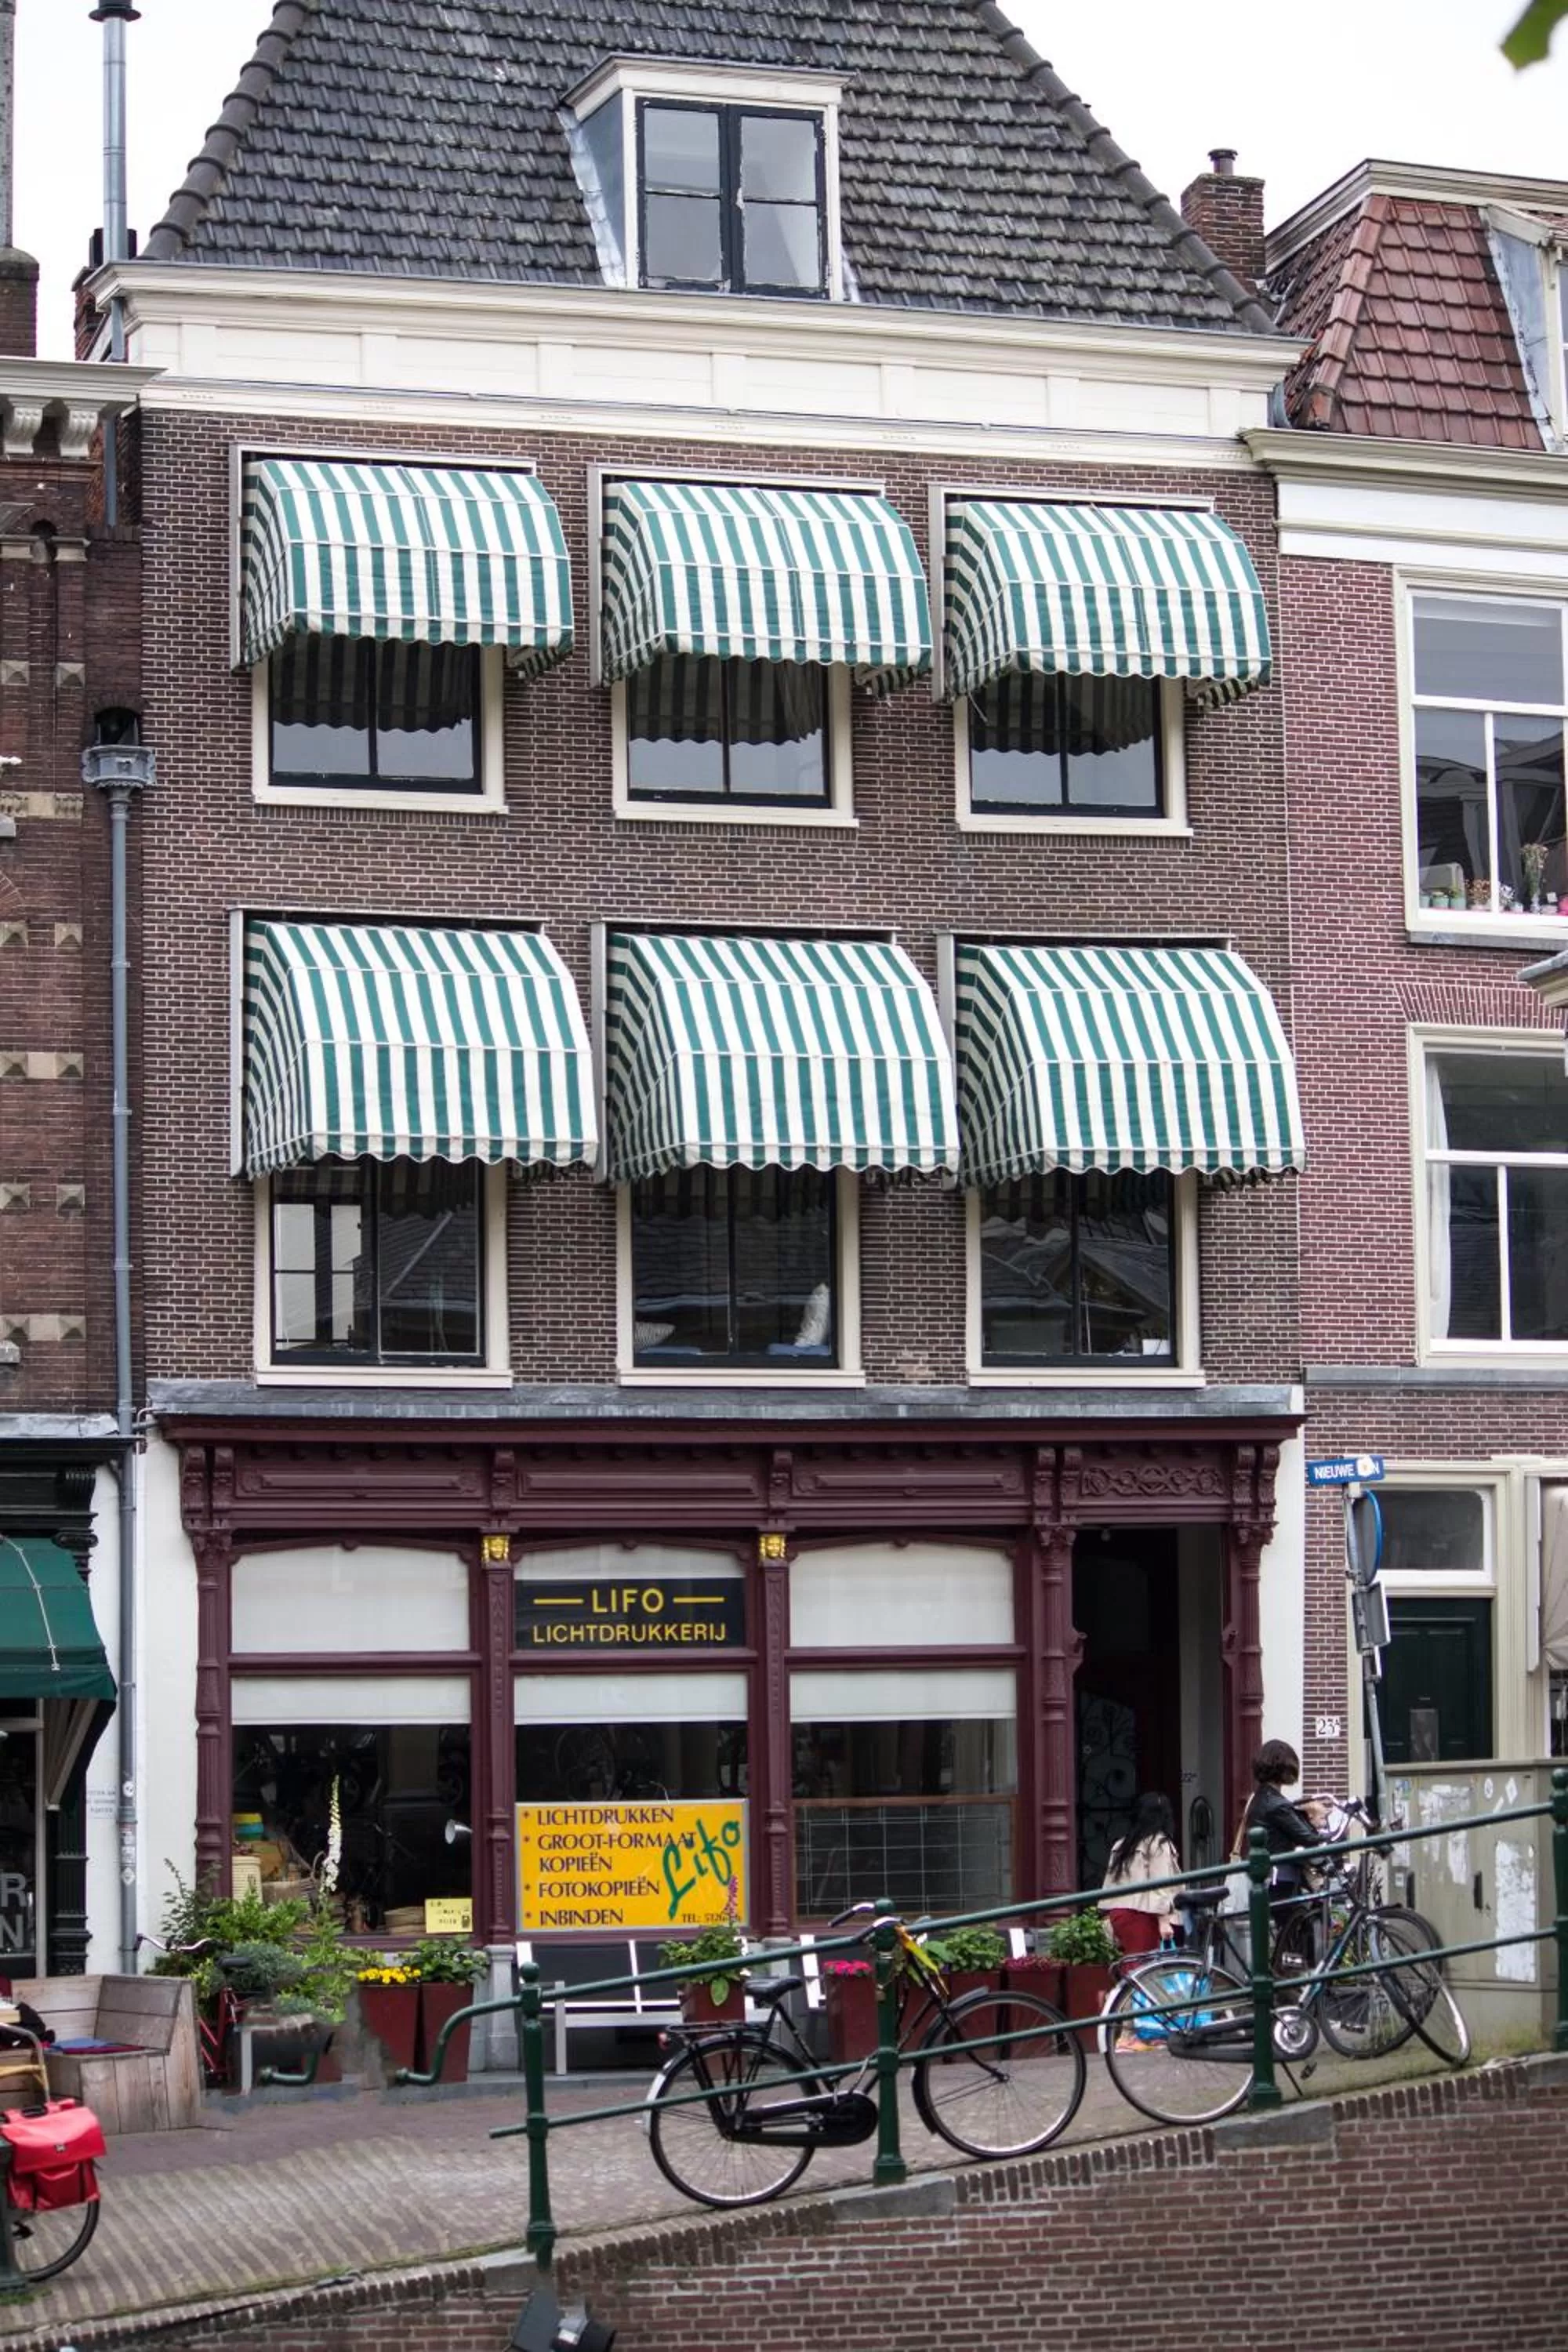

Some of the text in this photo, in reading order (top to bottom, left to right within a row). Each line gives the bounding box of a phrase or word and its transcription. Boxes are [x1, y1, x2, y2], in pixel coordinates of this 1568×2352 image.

[1314, 1464, 1355, 1479] NIEUWE
[592, 1588, 664, 1613] LIFO
[533, 1623, 726, 1643] LICHTDRUKKERIJ
[537, 1808, 674, 1826] LICHTDRUKKEN
[537, 1831, 697, 1850] GROOT-FORMAAT
[539, 1853, 612, 1873] KOPIEËN
[662, 1819, 741, 1919] Lifo
[539, 1876, 660, 1898] FOTOKOPIEËN
[539, 1908, 624, 1926] INBINDEN
